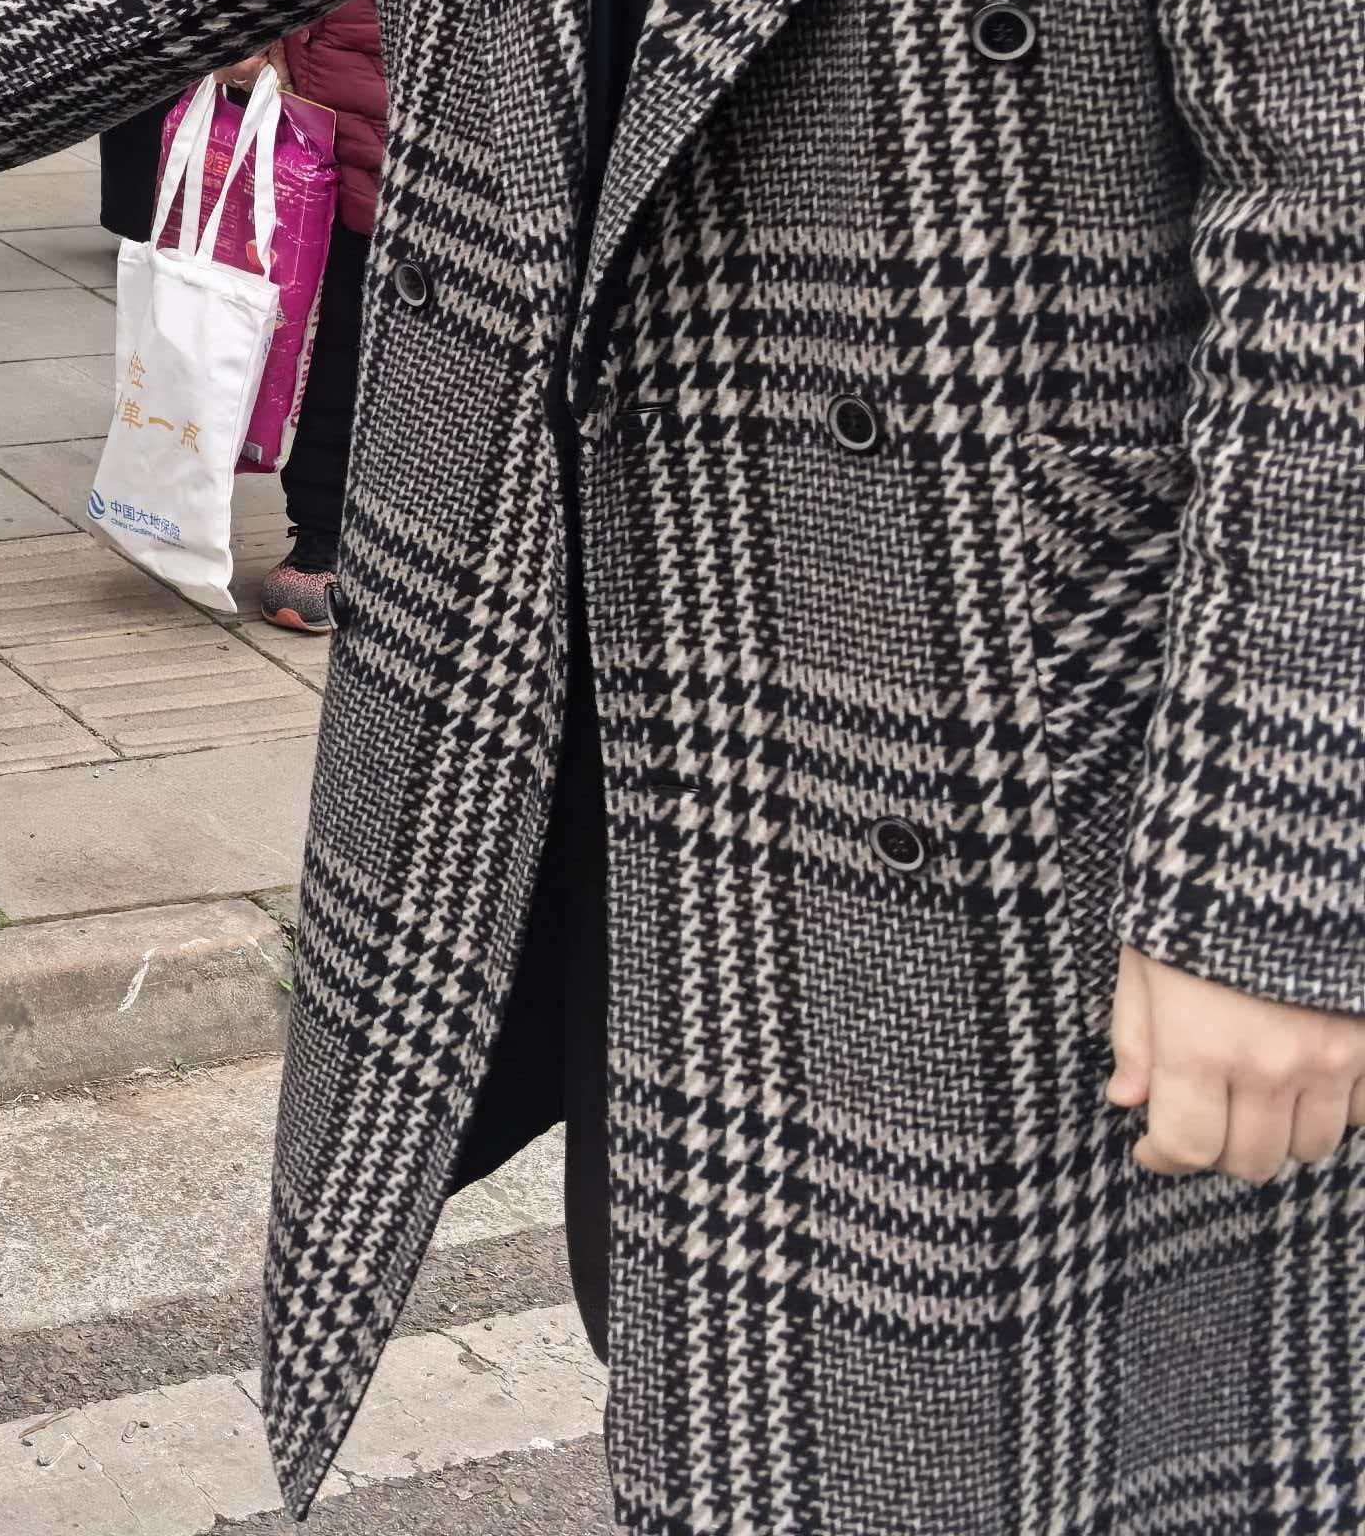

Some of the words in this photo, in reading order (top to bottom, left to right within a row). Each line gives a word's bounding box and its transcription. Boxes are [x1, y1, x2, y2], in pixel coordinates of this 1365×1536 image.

[117, 392, 203, 454] 单一点
[110, 499, 182, 541] 中国大地保险
